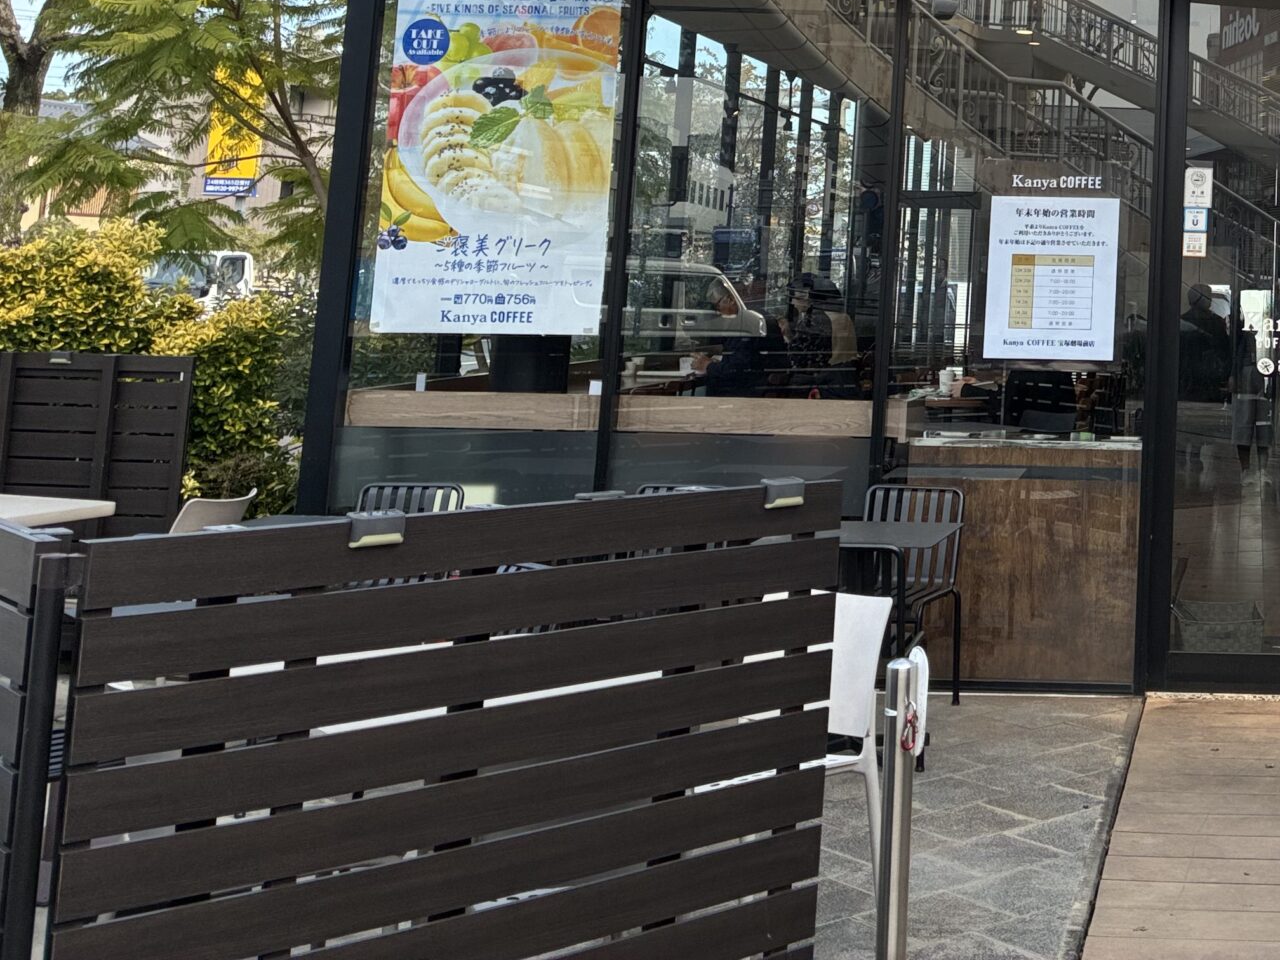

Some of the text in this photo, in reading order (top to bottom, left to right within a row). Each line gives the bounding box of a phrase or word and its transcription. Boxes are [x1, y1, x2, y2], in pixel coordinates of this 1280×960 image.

[454, 4, 484, 14] KINDS
[487, 4, 500, 14] OF
[502, 5, 556, 15] SEASONAL
[559, 5, 590, 16] FRUITS
[411, 28, 445, 39] TAKE
[413, 39, 439, 50] OUT
[407, 49, 444, 57] Available
[1012, 175, 1101, 190] Kanya COFFEE
[1016, 208, 1095, 219] 年末年始の営業時間
[463, 292, 536, 306] 770円 756円
[440, 310, 533, 326] Kanya COFFEE
[1003, 339, 1024, 347] Kanya
